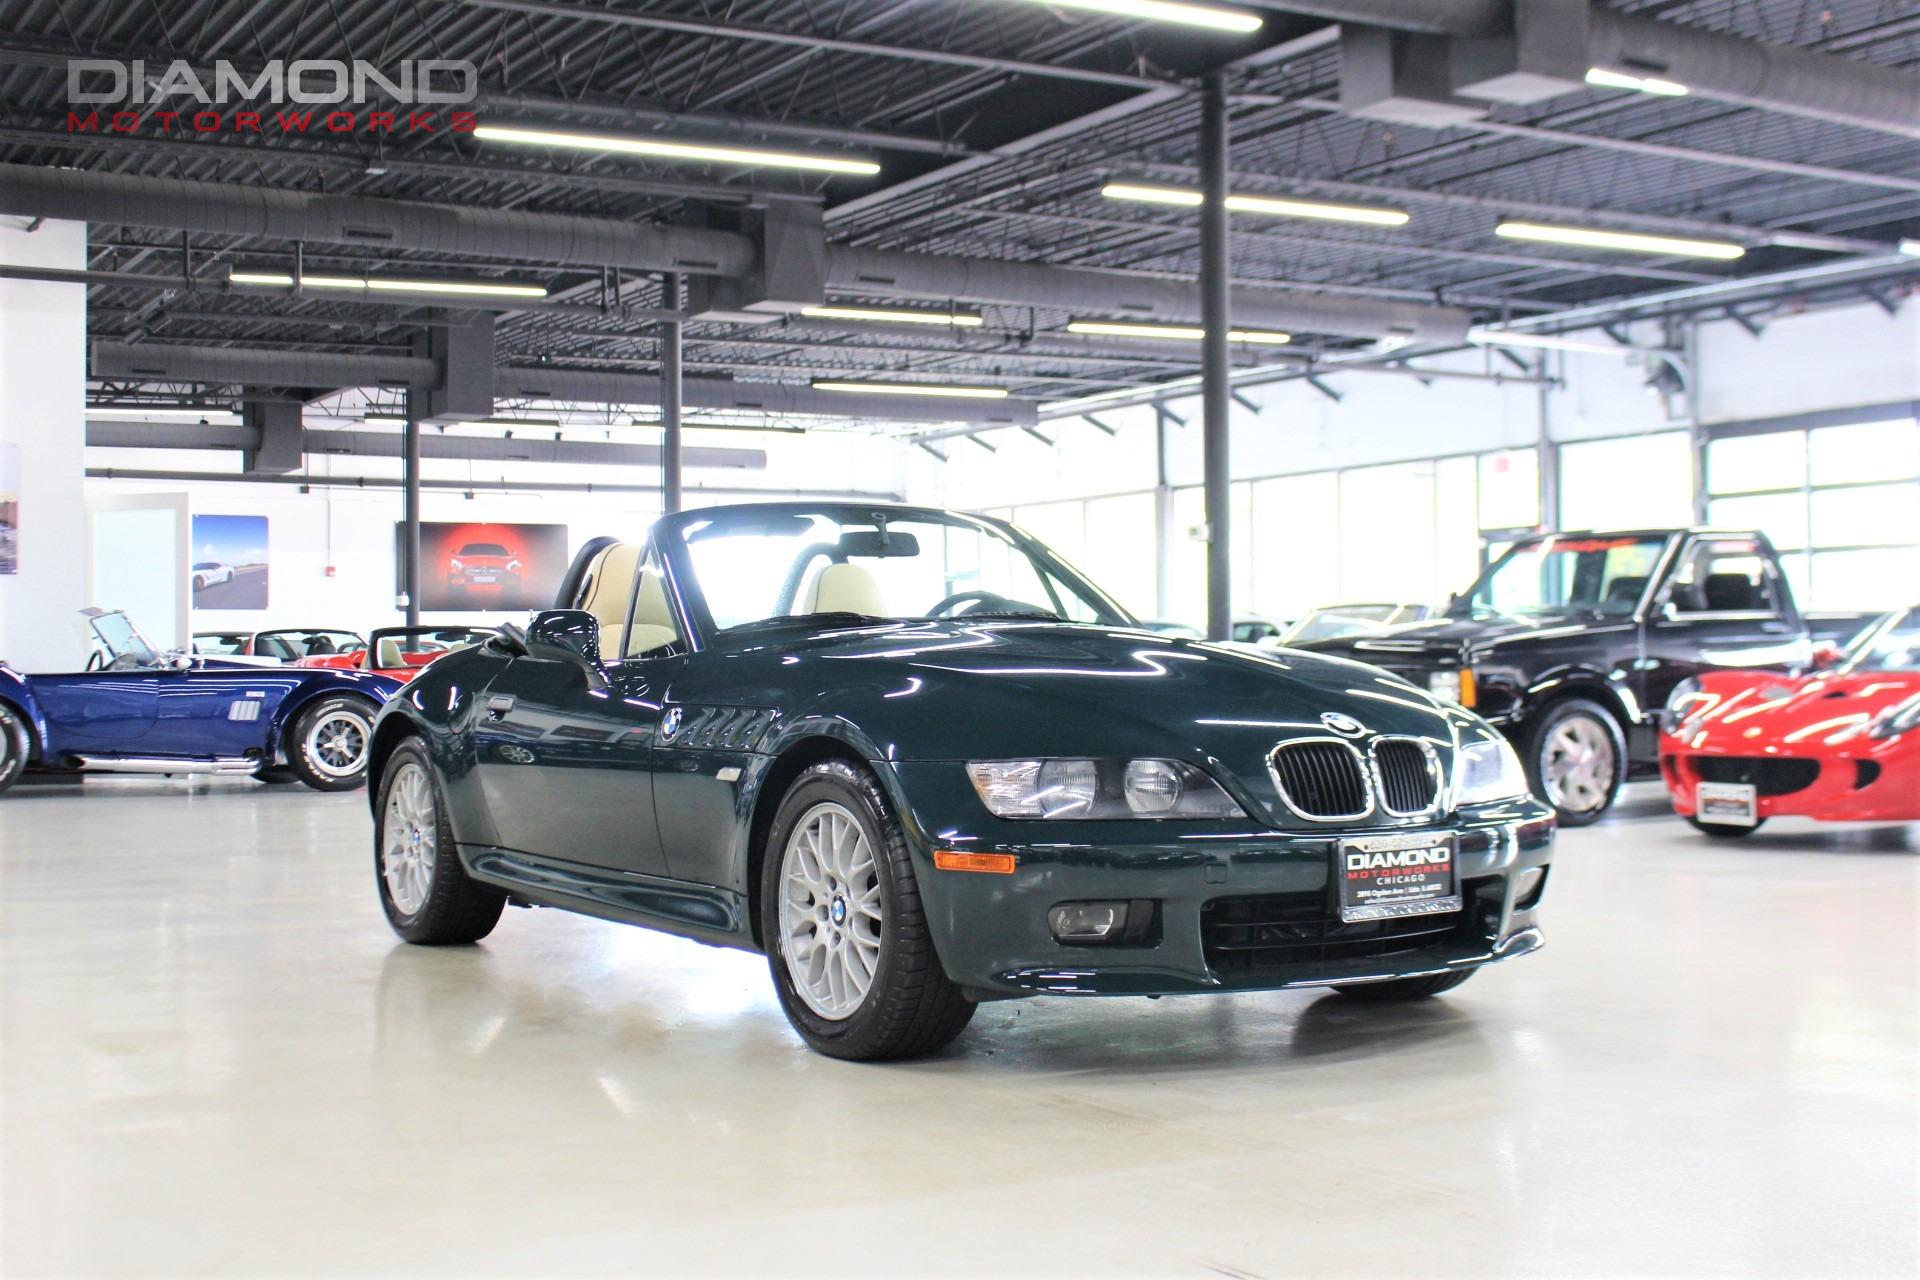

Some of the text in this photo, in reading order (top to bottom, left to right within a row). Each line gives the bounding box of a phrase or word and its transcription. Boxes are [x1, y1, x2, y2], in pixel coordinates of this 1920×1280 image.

[1347, 847, 1451, 870] DIAMOND
[1347, 863, 1451, 880] MOTORWORKS
[1376, 873, 1425, 886] CHICAGO
